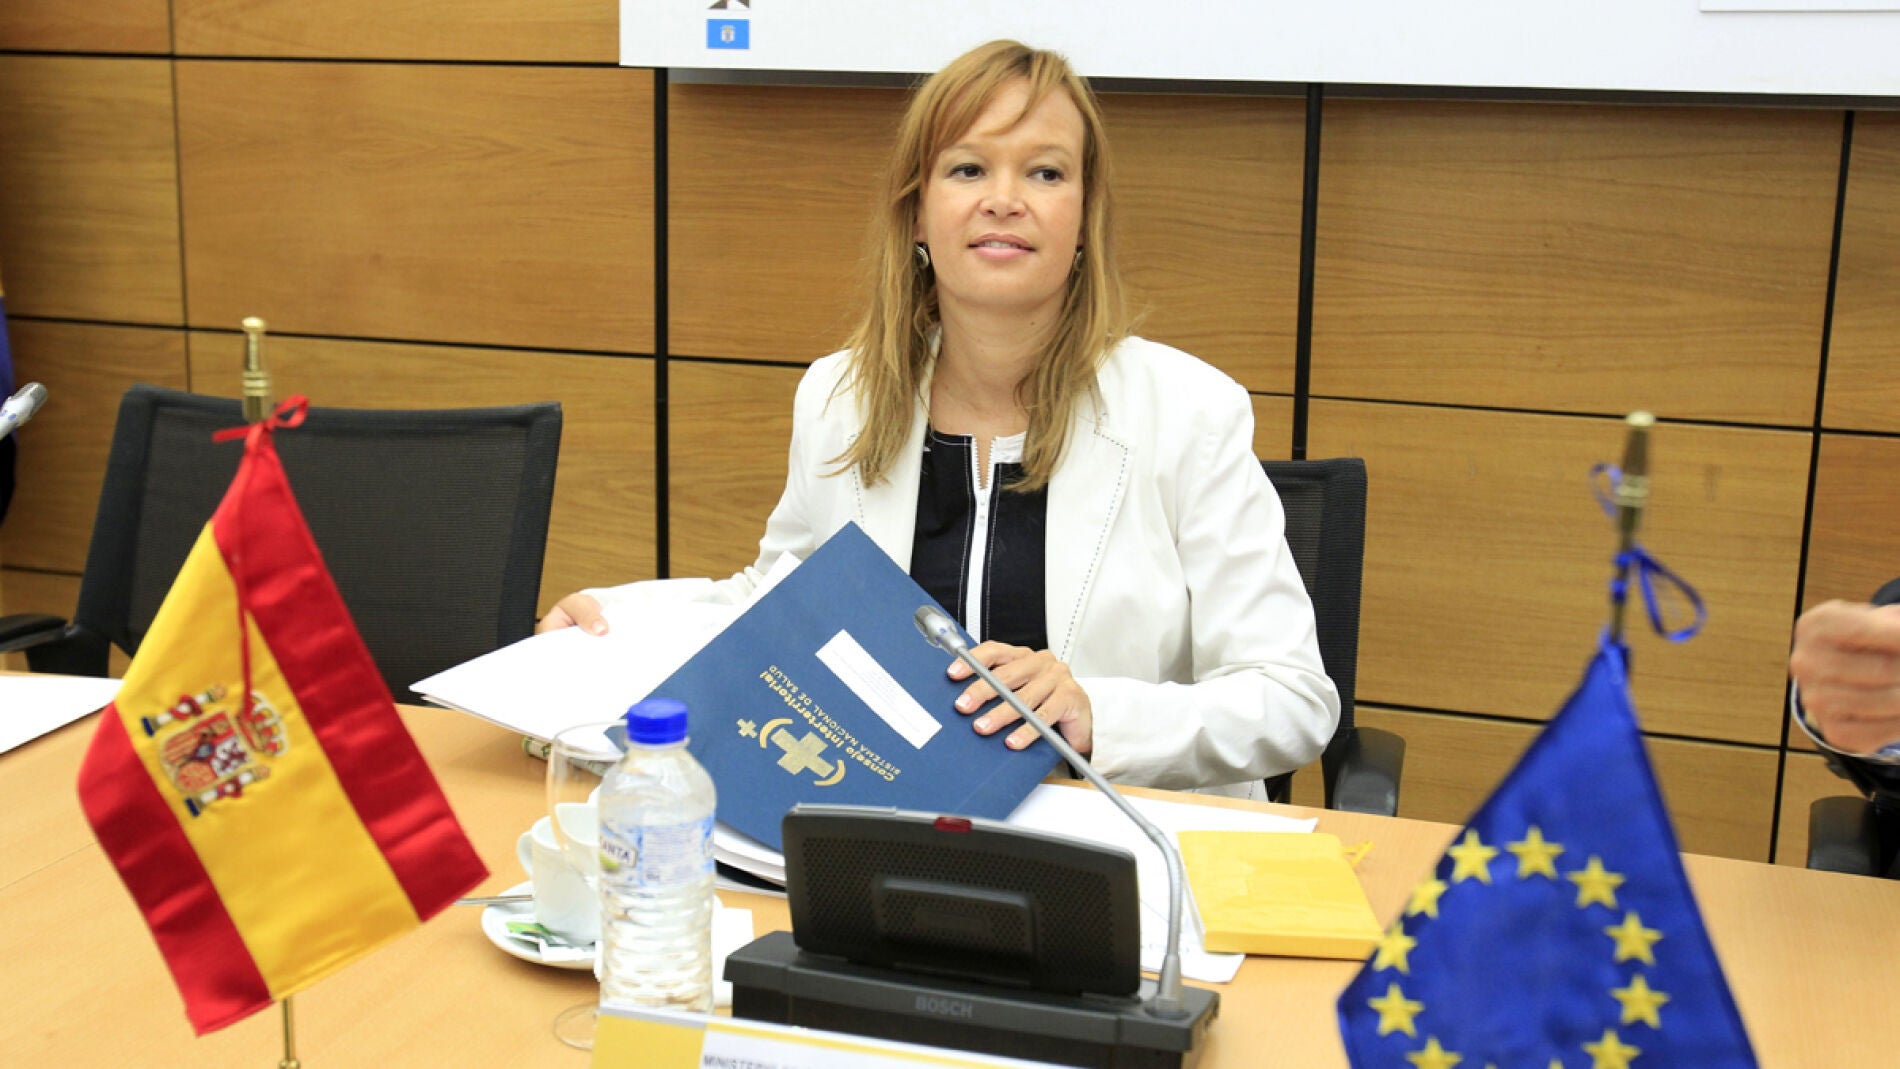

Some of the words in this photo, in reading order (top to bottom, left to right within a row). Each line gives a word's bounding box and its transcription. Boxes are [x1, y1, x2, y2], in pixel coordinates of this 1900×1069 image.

[769, 665, 799, 693] SALUD
[798, 692, 813, 706] DE
[814, 704, 859, 746] NACIONAL
[846, 746, 895, 781] Consejo
[860, 744, 901, 775] SISTEMA
[915, 996, 973, 1018] BOSCH
